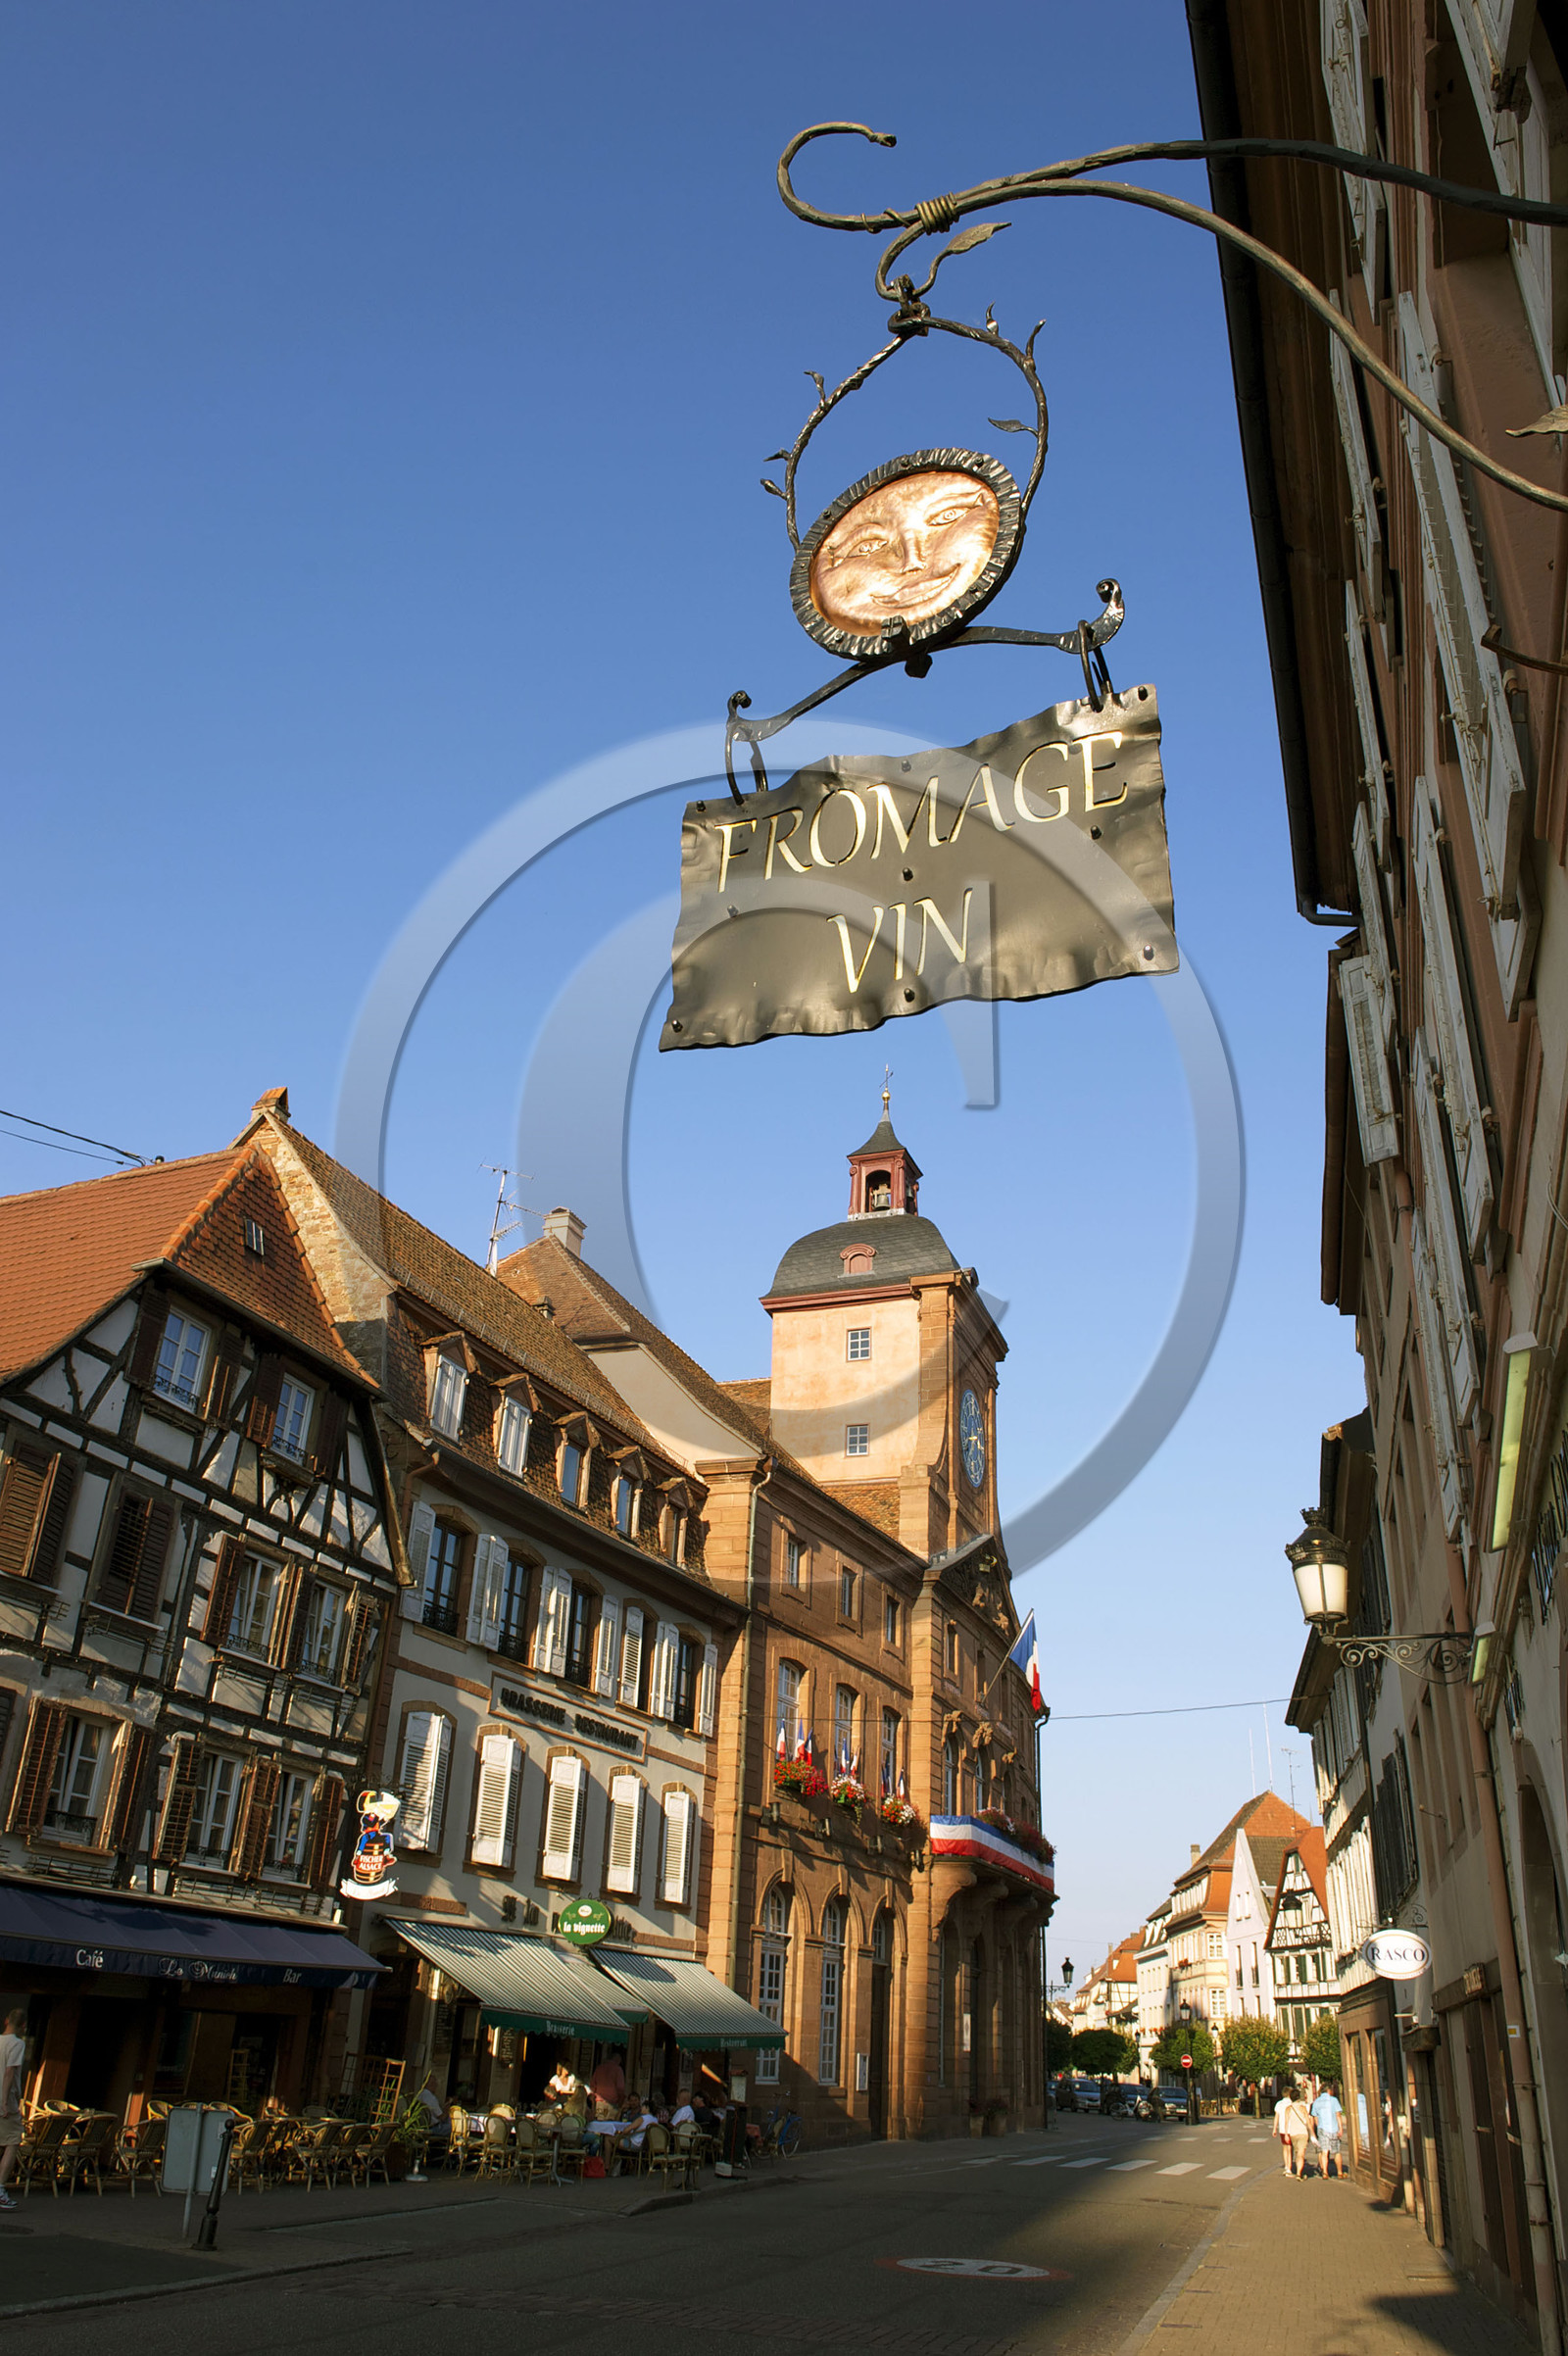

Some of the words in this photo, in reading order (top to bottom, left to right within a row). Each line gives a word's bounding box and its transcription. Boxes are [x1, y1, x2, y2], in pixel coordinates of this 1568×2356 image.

[713, 730, 1129, 893] FROMAGE
[826, 887, 973, 994] VIN
[501, 1688, 566, 1725] BRASSERIE
[575, 1713, 639, 1750] RESTAURANT
[358, 1862, 381, 1871] ALSACE
[359, 1854, 383, 1863] FISCHER
[563, 1921, 571, 1933] la
[573, 1922, 606, 1936] vignette
[1371, 1946, 1426, 1962] RASCO
[75, 1948, 104, 1969] Café
[282, 1968, 303, 1985] Bar
[545, 2019, 575, 2037] Brasserie
